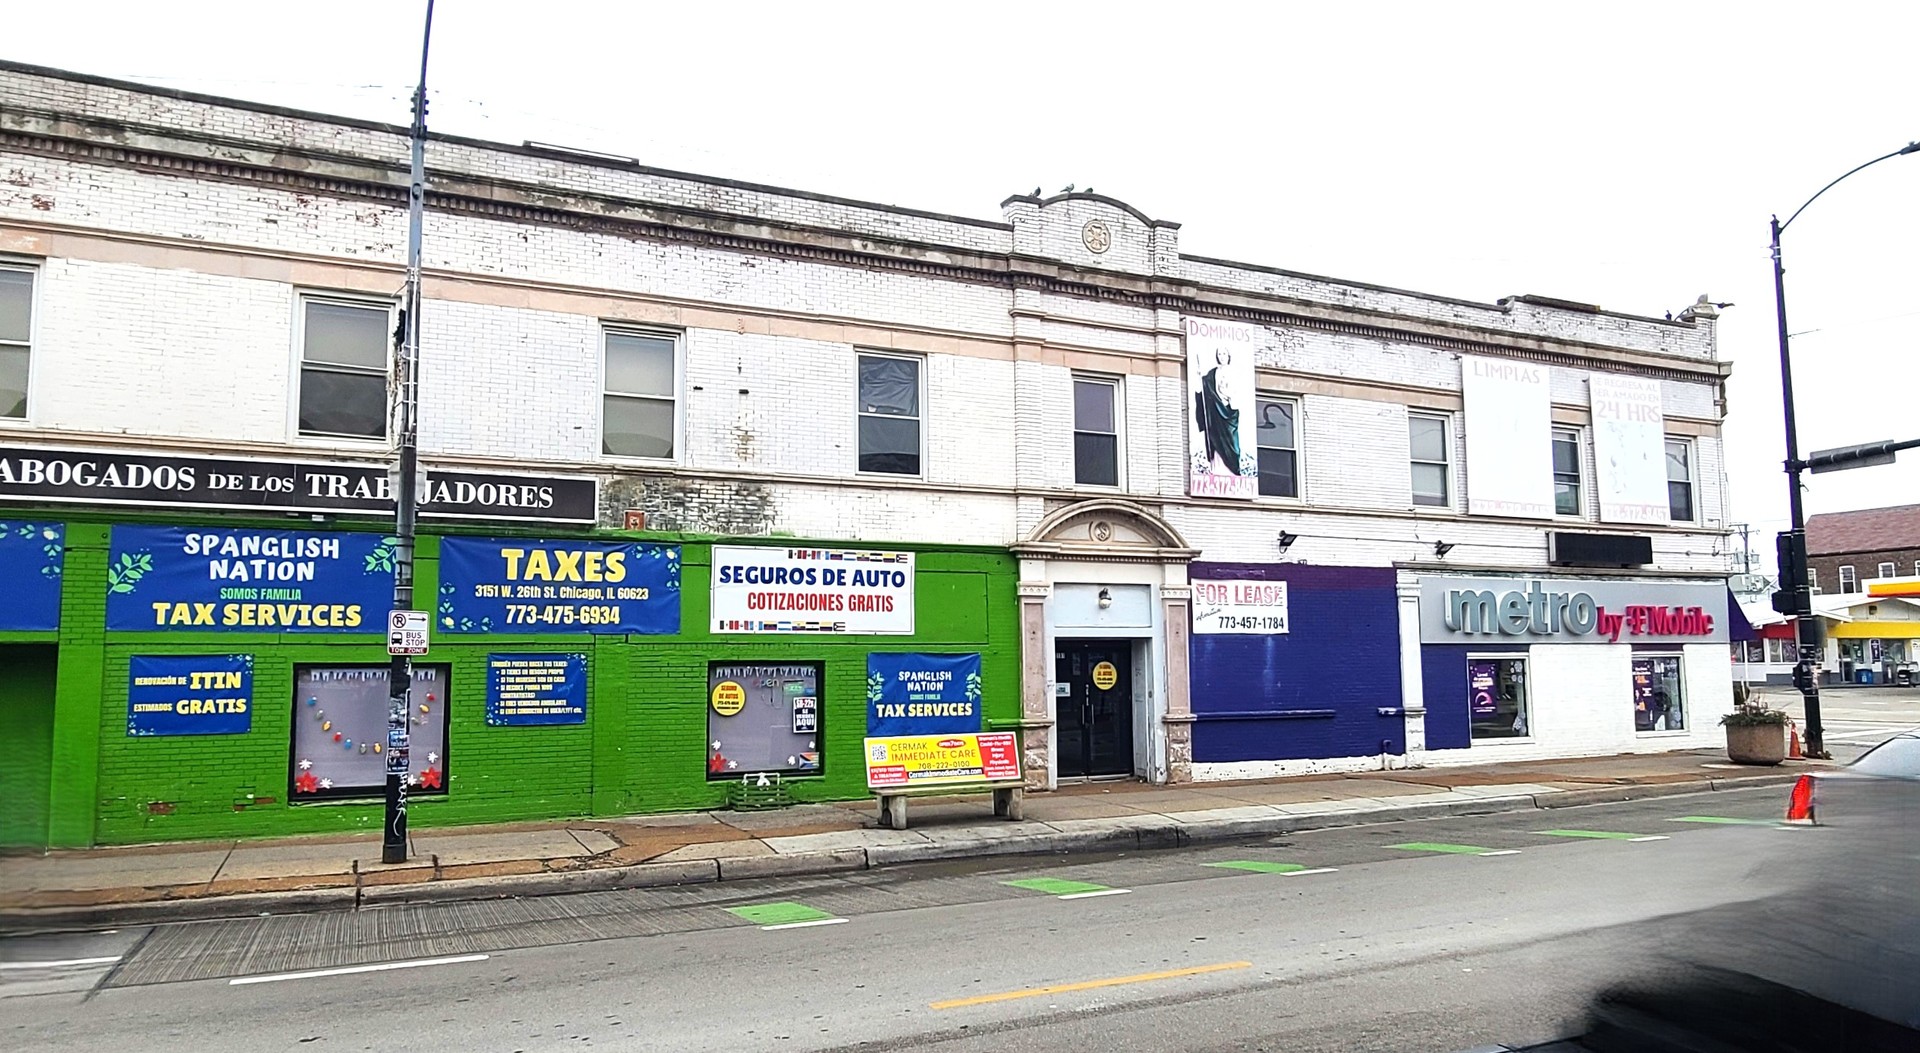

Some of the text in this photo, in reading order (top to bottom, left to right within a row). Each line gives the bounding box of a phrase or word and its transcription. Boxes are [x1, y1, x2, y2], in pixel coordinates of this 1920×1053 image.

[1189, 319, 1250, 343] DOMINIOS
[1473, 360, 1541, 384] LIMPIAS
[1595, 400, 1661, 423] 24 HRS
[0, 457, 554, 508] ABOGADOS DE LOS TRABJADORES
[183, 533, 340, 559] SPANGLISH
[209, 559, 315, 582] NATION
[501, 548, 626, 583] TAXES
[719, 565, 906, 588] SEGUROS DE AUTO
[220, 588, 302, 601] SOMOS FAMILIA
[475, 584, 649, 601] 3151 W. 26th St. Chicago, IL 60623
[747, 592, 894, 612] COTIZACIONES GRATIS
[1196, 583, 1284, 607] FOR LEASE
[152, 602, 362, 627] TAX SERVICES
[505, 604, 620, 624] 773-475-6934
[1444, 580, 1597, 635] metro
[1597, 606, 1625, 643] by
[1218, 616, 1284, 630] 773-457-1784
[178, 677, 187, 685] DE
[190, 672, 242, 689] ITIN
[898, 670, 952, 682] SPANGLISH
[907, 682, 944, 692] NATION
[176, 698, 247, 715] GRATIS
[876, 703, 973, 718] TAX SERVICES
[890, 743, 928, 752] CERMAK
[891, 749, 976, 762] IMMEDIATE CARE
[917, 761, 970, 770] 708-222-0100
